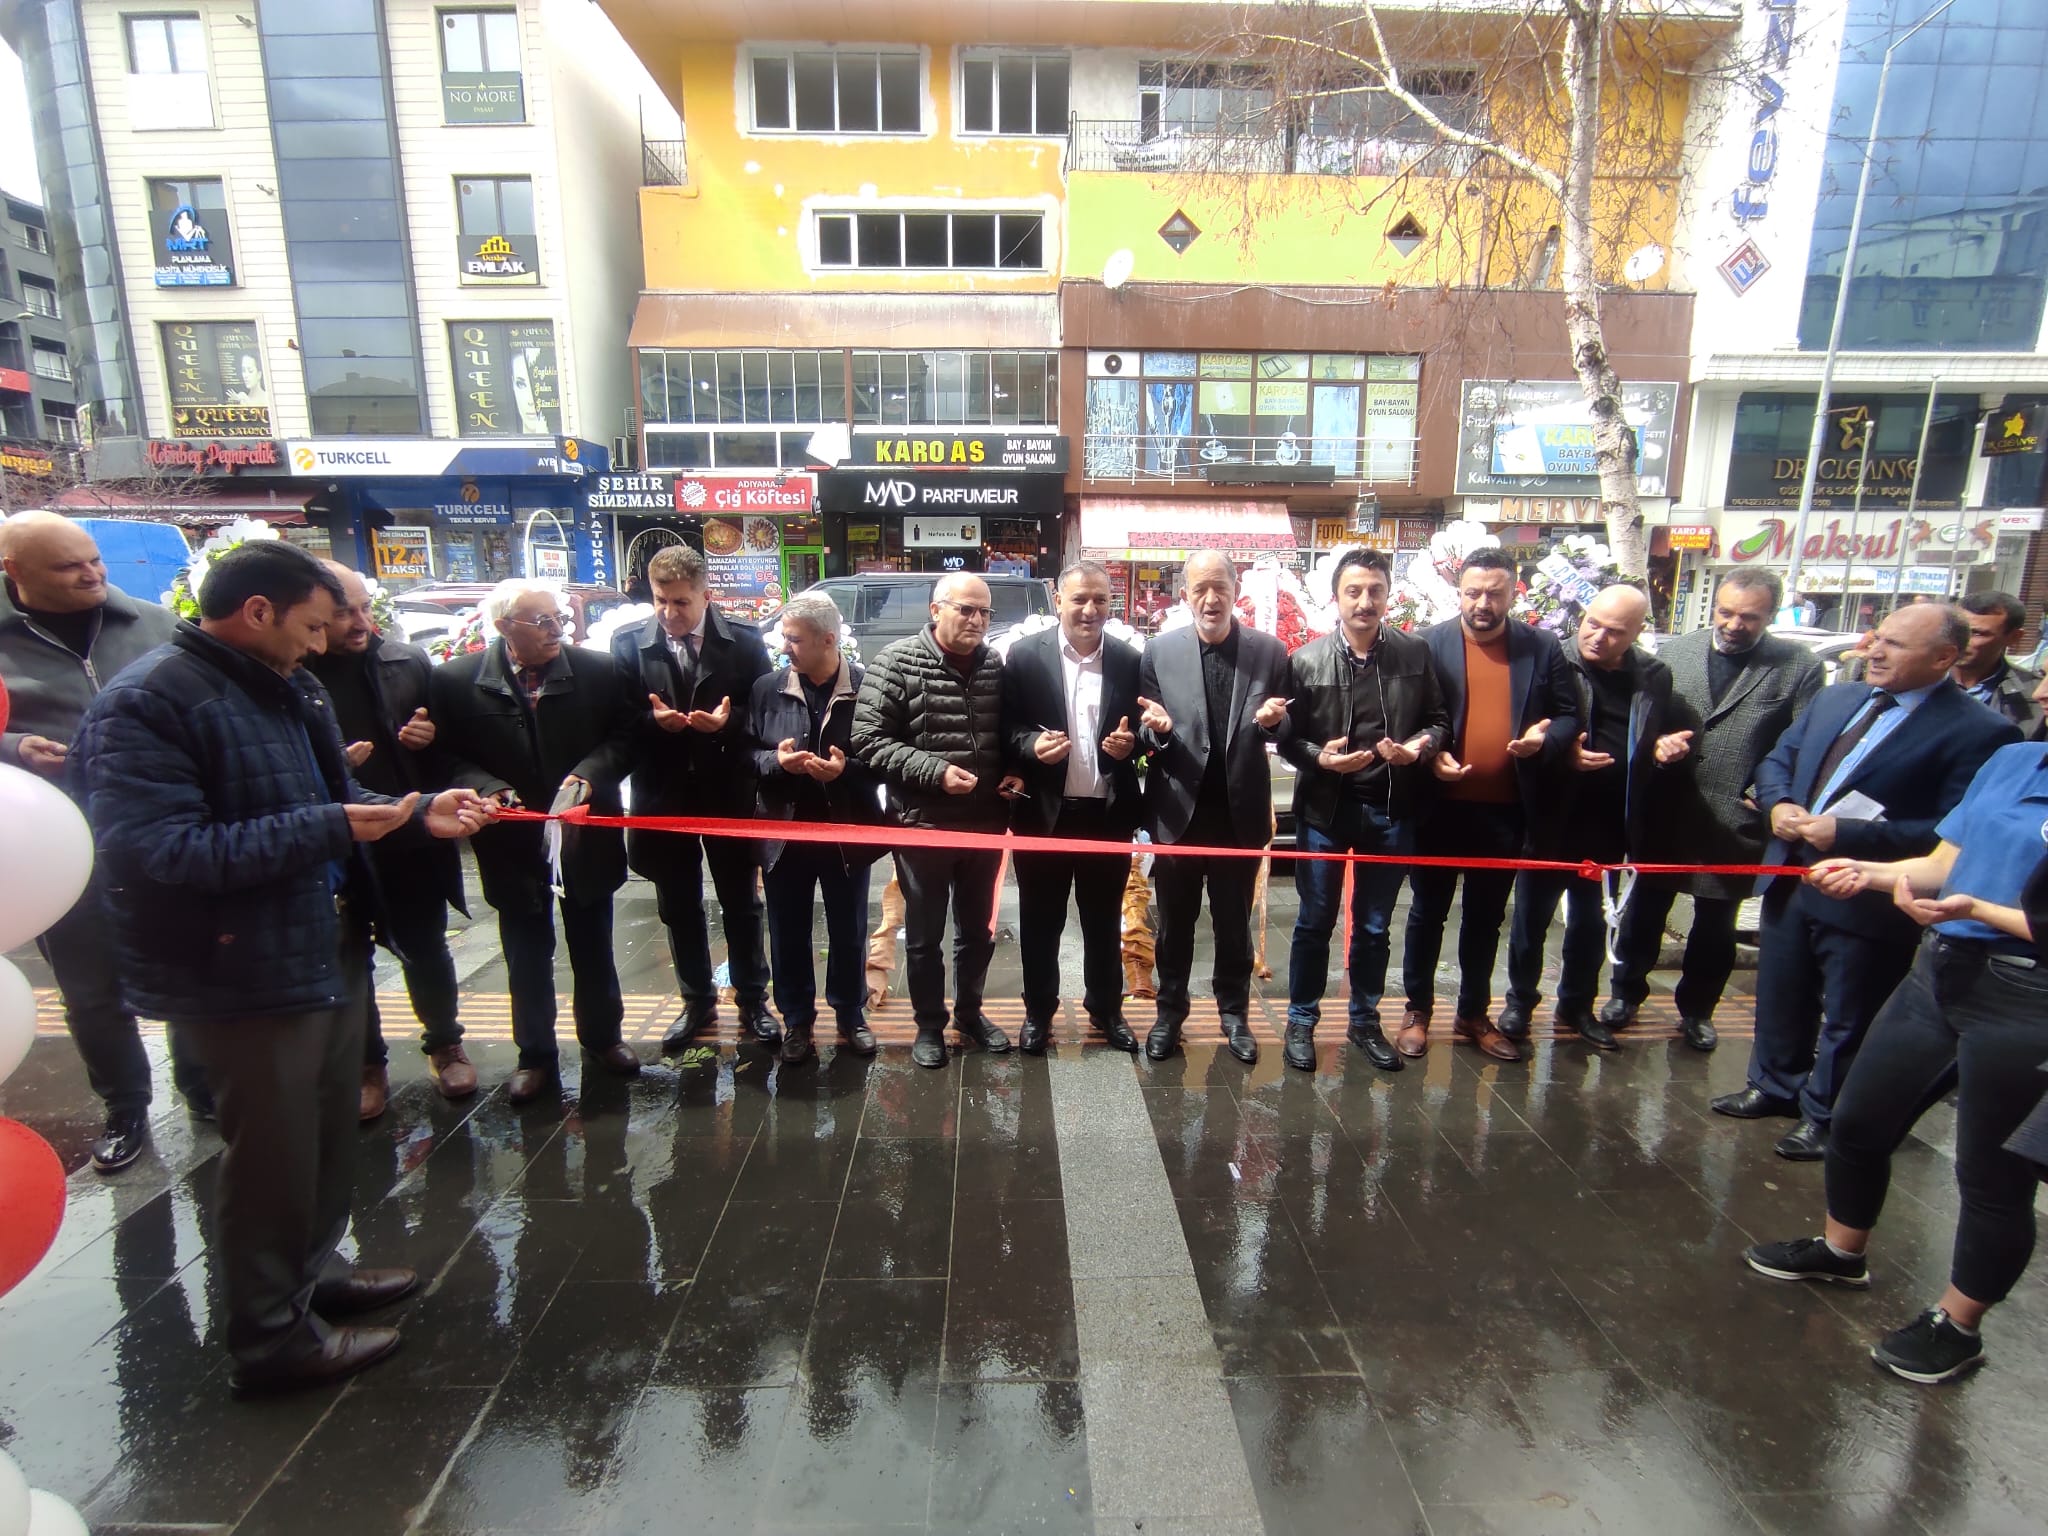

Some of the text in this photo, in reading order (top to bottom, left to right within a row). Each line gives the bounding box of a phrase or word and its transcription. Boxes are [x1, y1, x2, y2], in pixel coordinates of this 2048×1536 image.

[450, 91, 517, 103] NO MORE
[467, 261, 526, 273] EMLAK
[463, 327, 500, 429] QUEEN
[195, 408, 269, 426] QUEEN
[1367, 408, 1416, 416] OYUN SALONU
[1545, 427, 1595, 446] KAR
[876, 440, 985, 463] KARO AS
[1006, 440, 1022, 451] BAY
[1027, 440, 1051, 451] BAYAN
[318, 452, 391, 464] TURKCELL
[1003, 453, 1056, 464] OYUN SALONU
[1558, 449, 1597, 459] BAY-B
[1547, 463, 1580, 473] OYUN
[599, 473, 664, 496] ŞEHİR
[588, 491, 676, 508] SİNEMASI
[715, 489, 806, 508] Çiğ Köftesi
[864, 479, 1018, 507] MAD PARFUMEUR
[435, 504, 509, 515] TURKCELL
[1317, 524, 1343, 539] FOTO
[1671, 527, 1712, 535] KARO AS
[379, 545, 426, 565] 12 AY
